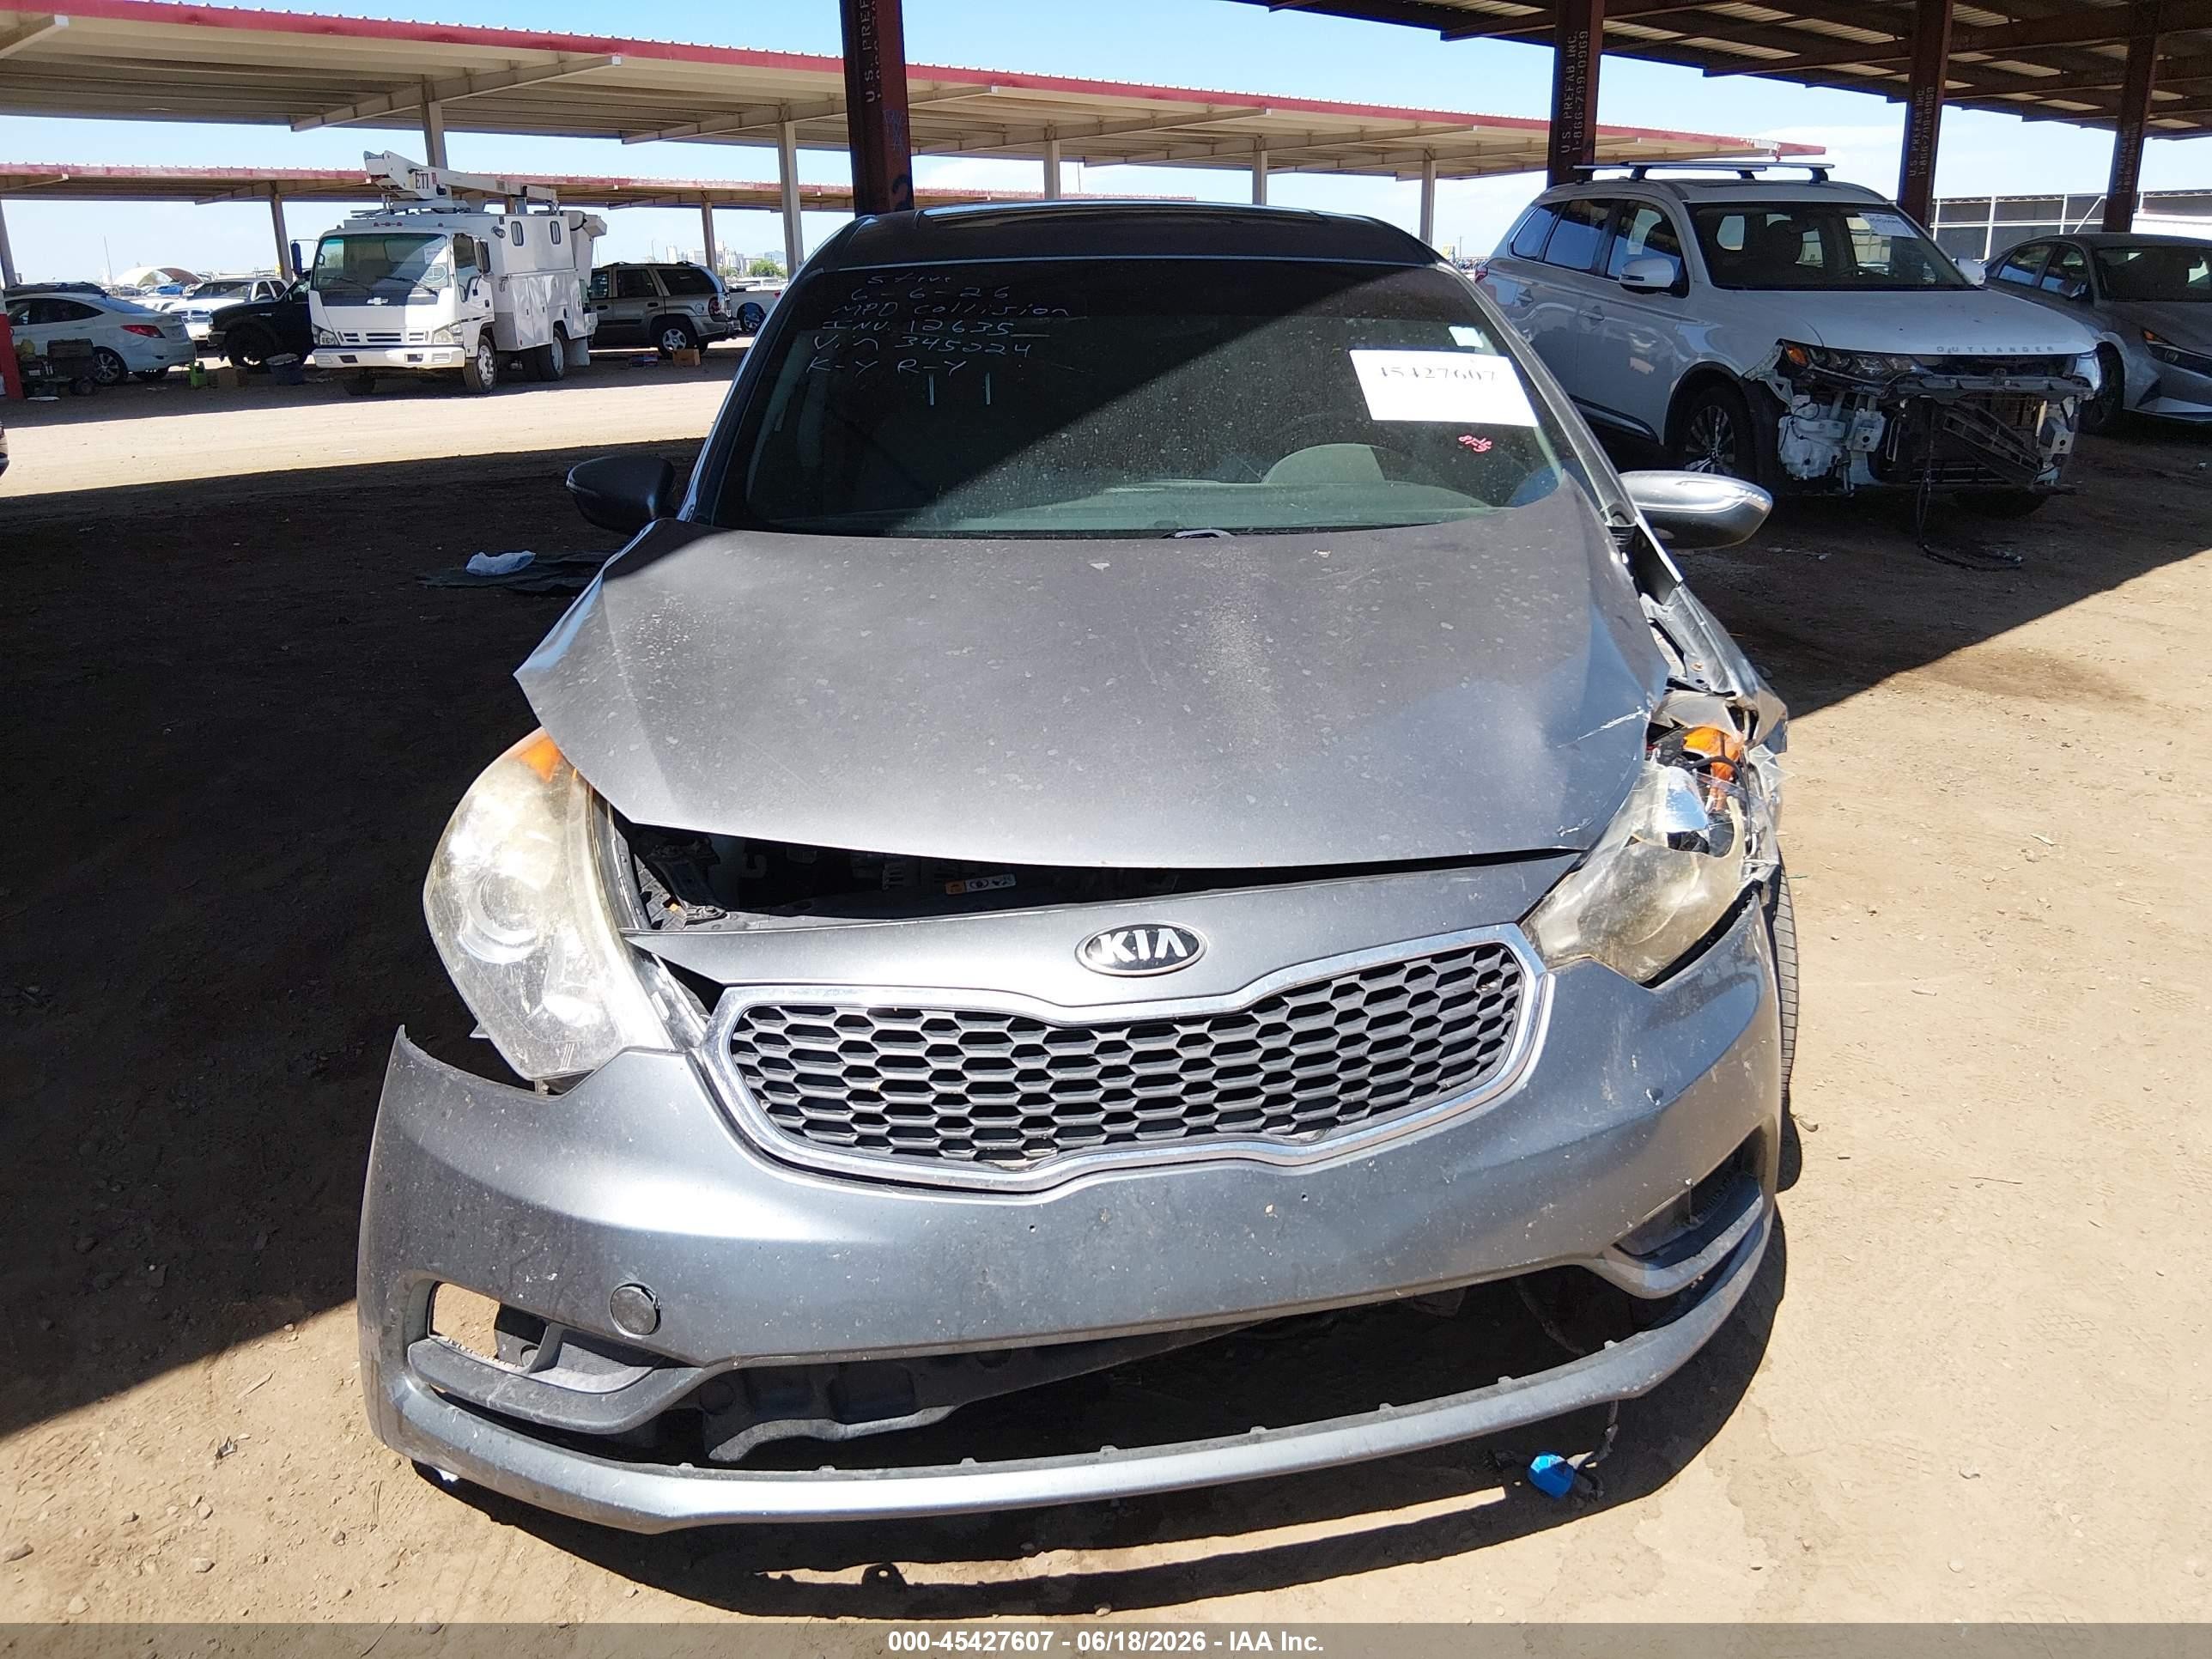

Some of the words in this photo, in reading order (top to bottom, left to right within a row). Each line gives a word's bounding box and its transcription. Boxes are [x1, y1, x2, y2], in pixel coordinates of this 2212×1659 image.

[1563, 64, 1576, 119] PREFAB
[415, 173, 429, 190] ETI
[908, 319, 1017, 337] 12635
[1097, 927, 1189, 964] KIA
